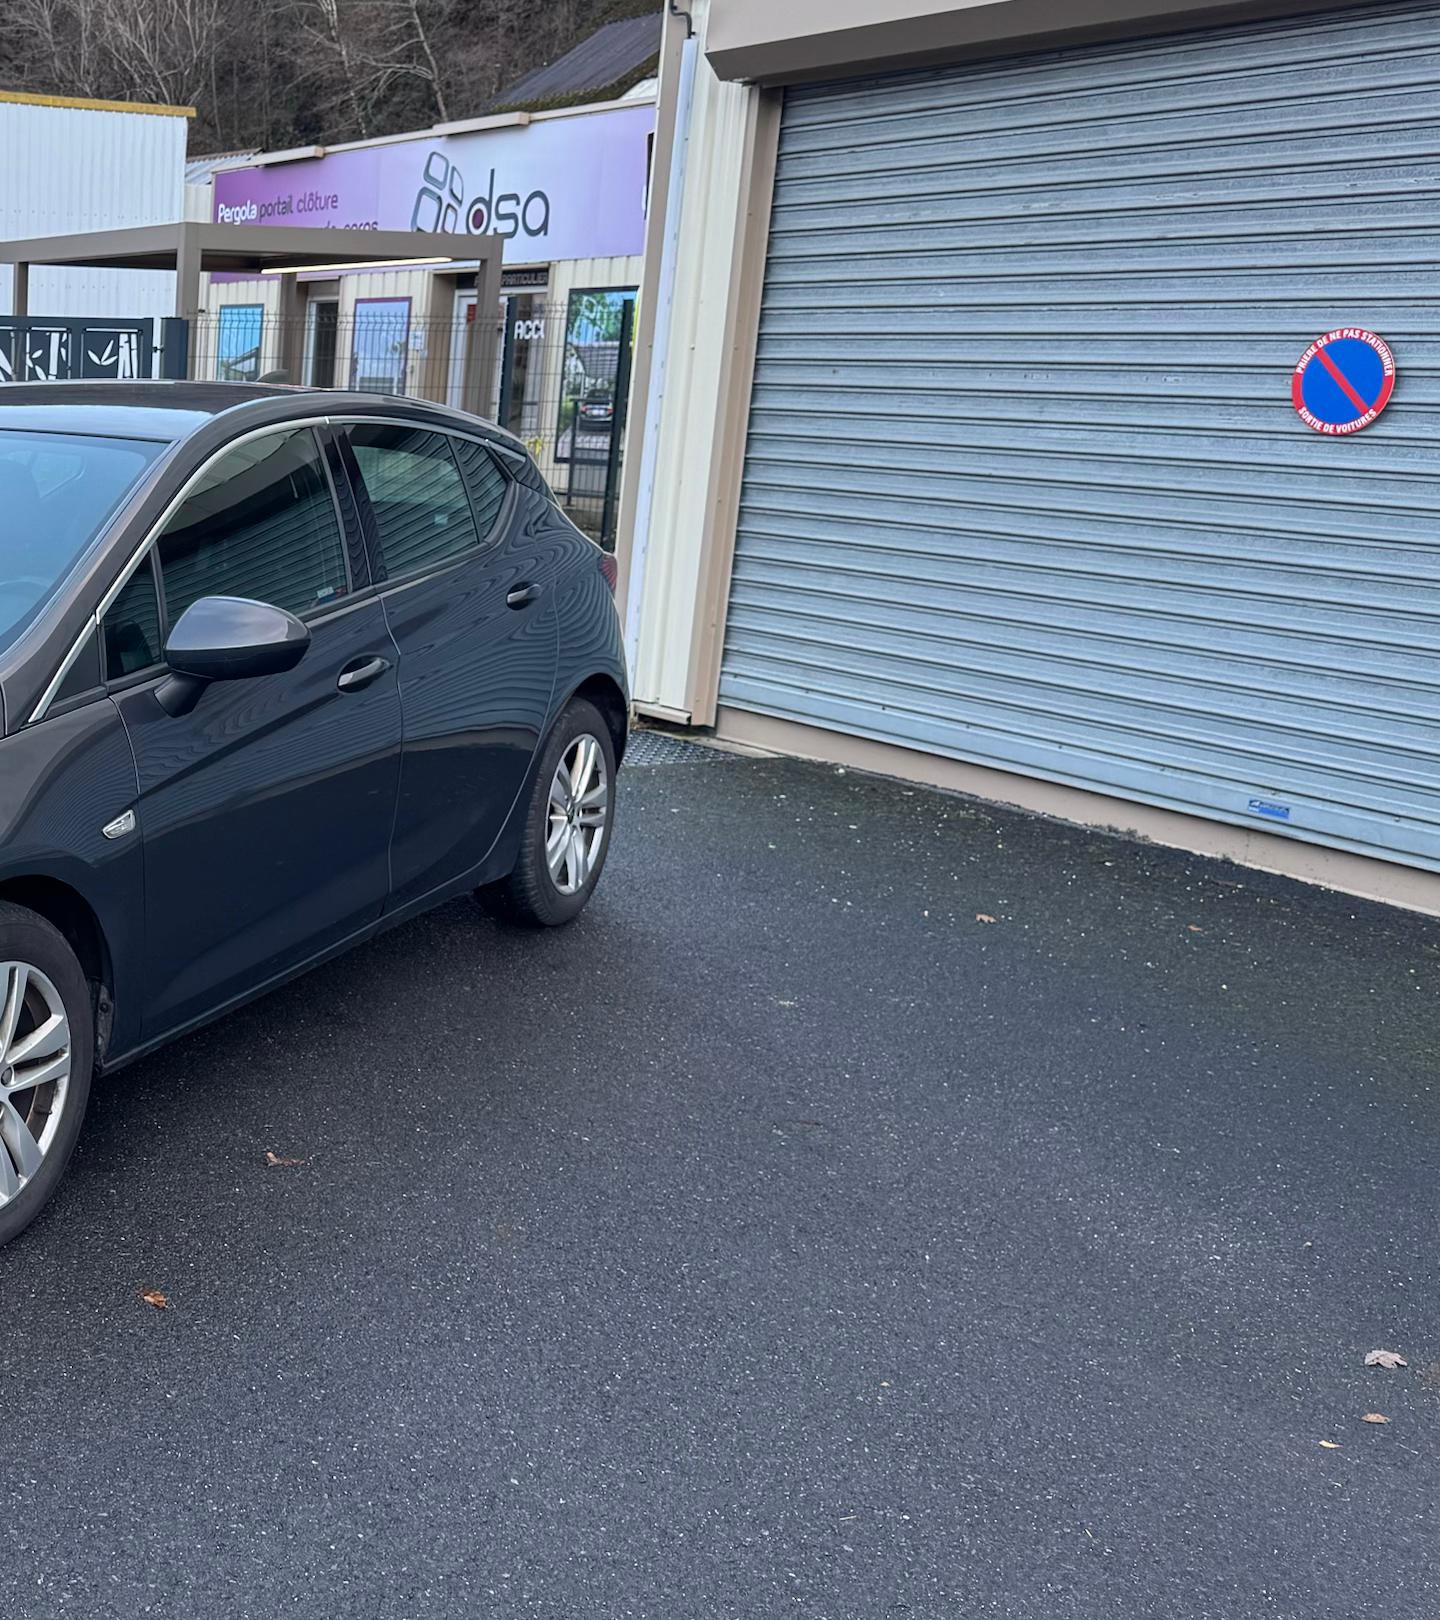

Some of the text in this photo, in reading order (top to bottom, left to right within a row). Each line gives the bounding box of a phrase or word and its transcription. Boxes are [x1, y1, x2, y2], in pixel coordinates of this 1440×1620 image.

[217, 190, 339, 225] Pergola portail clôture
[465, 168, 551, 239] dsa
[1317, 336, 1328, 348] DE
[1329, 330, 1341, 341] NE
[1343, 328, 1360, 339] PAS
[1298, 406, 1377, 433] SORTIE DE VOITURES
